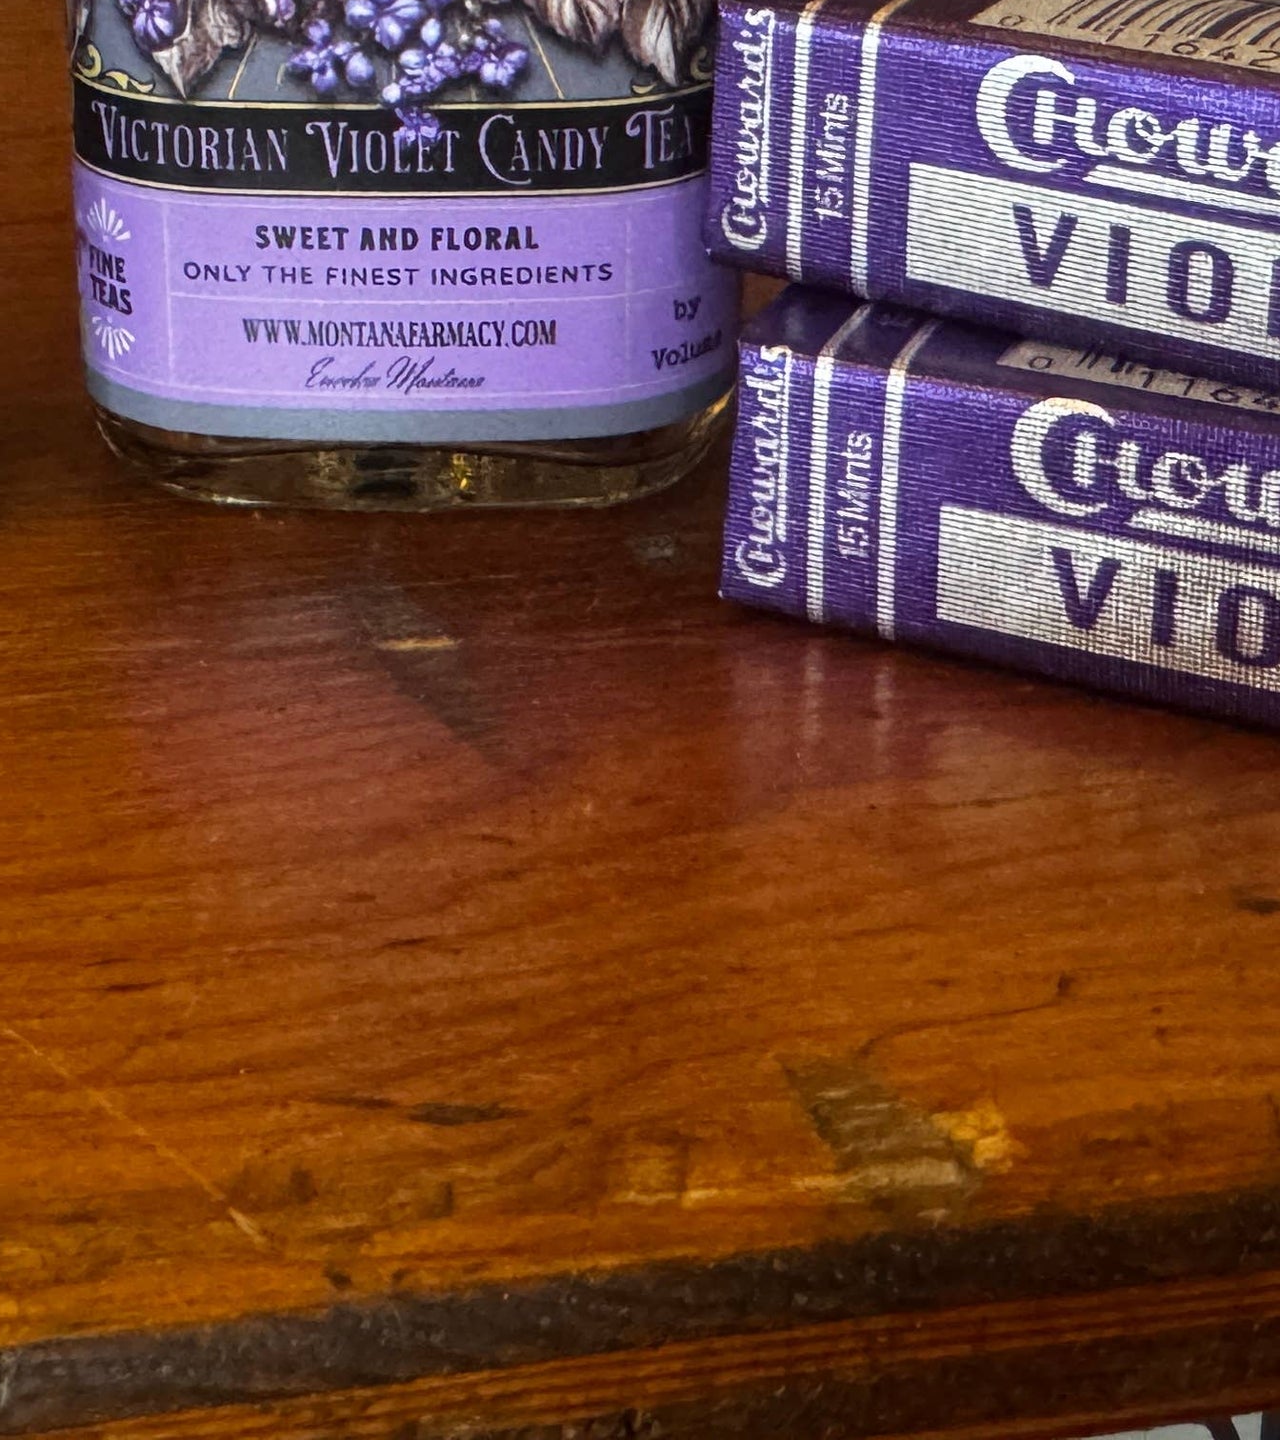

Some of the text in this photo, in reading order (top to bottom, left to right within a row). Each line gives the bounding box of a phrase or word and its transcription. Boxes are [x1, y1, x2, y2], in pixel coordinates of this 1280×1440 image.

[255, 224, 539, 253] SWEET AND FLORAL
[88, 243, 127, 284] FINE
[182, 261, 615, 287] ONLY THE FINEST INGREDIENTS
[89, 272, 134, 315] TEAS
[241, 317, 558, 350] WWW.MONTANAFARMACY.COM
